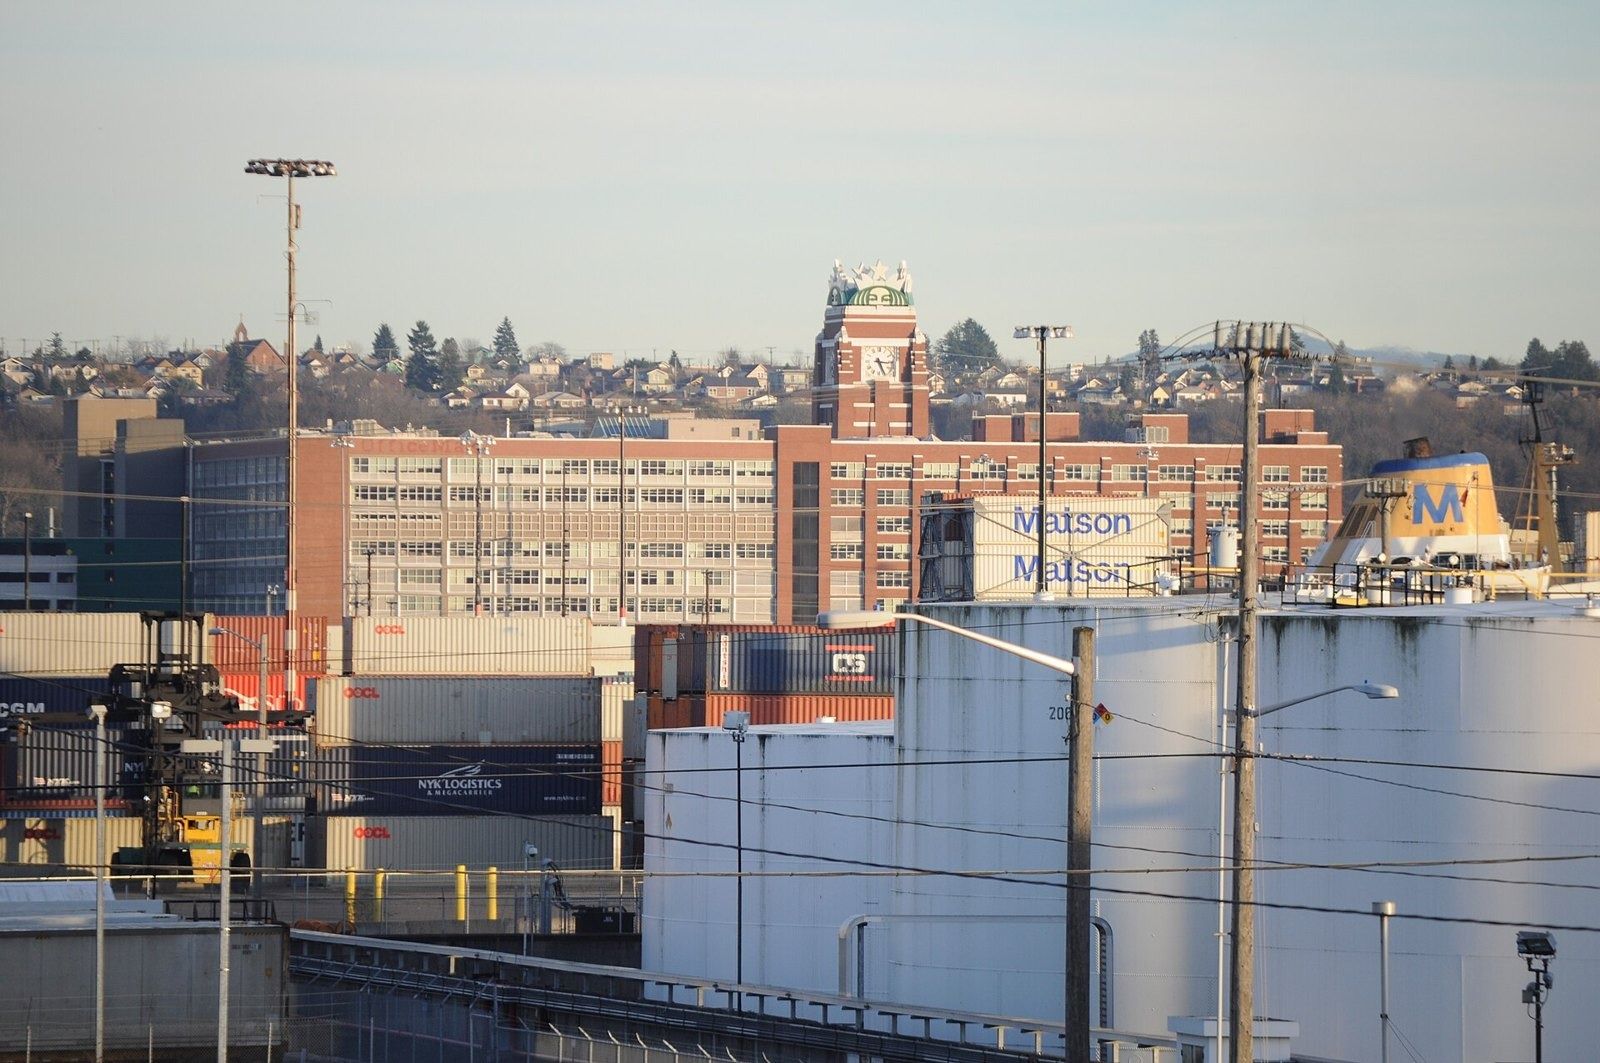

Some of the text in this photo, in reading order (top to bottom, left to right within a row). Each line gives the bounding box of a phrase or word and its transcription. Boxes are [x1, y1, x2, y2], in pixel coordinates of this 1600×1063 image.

[1412, 483, 1463, 524] M
[1014, 506, 1131, 534] Matson
[418, 779, 502, 789] NYK LOGISTICS
